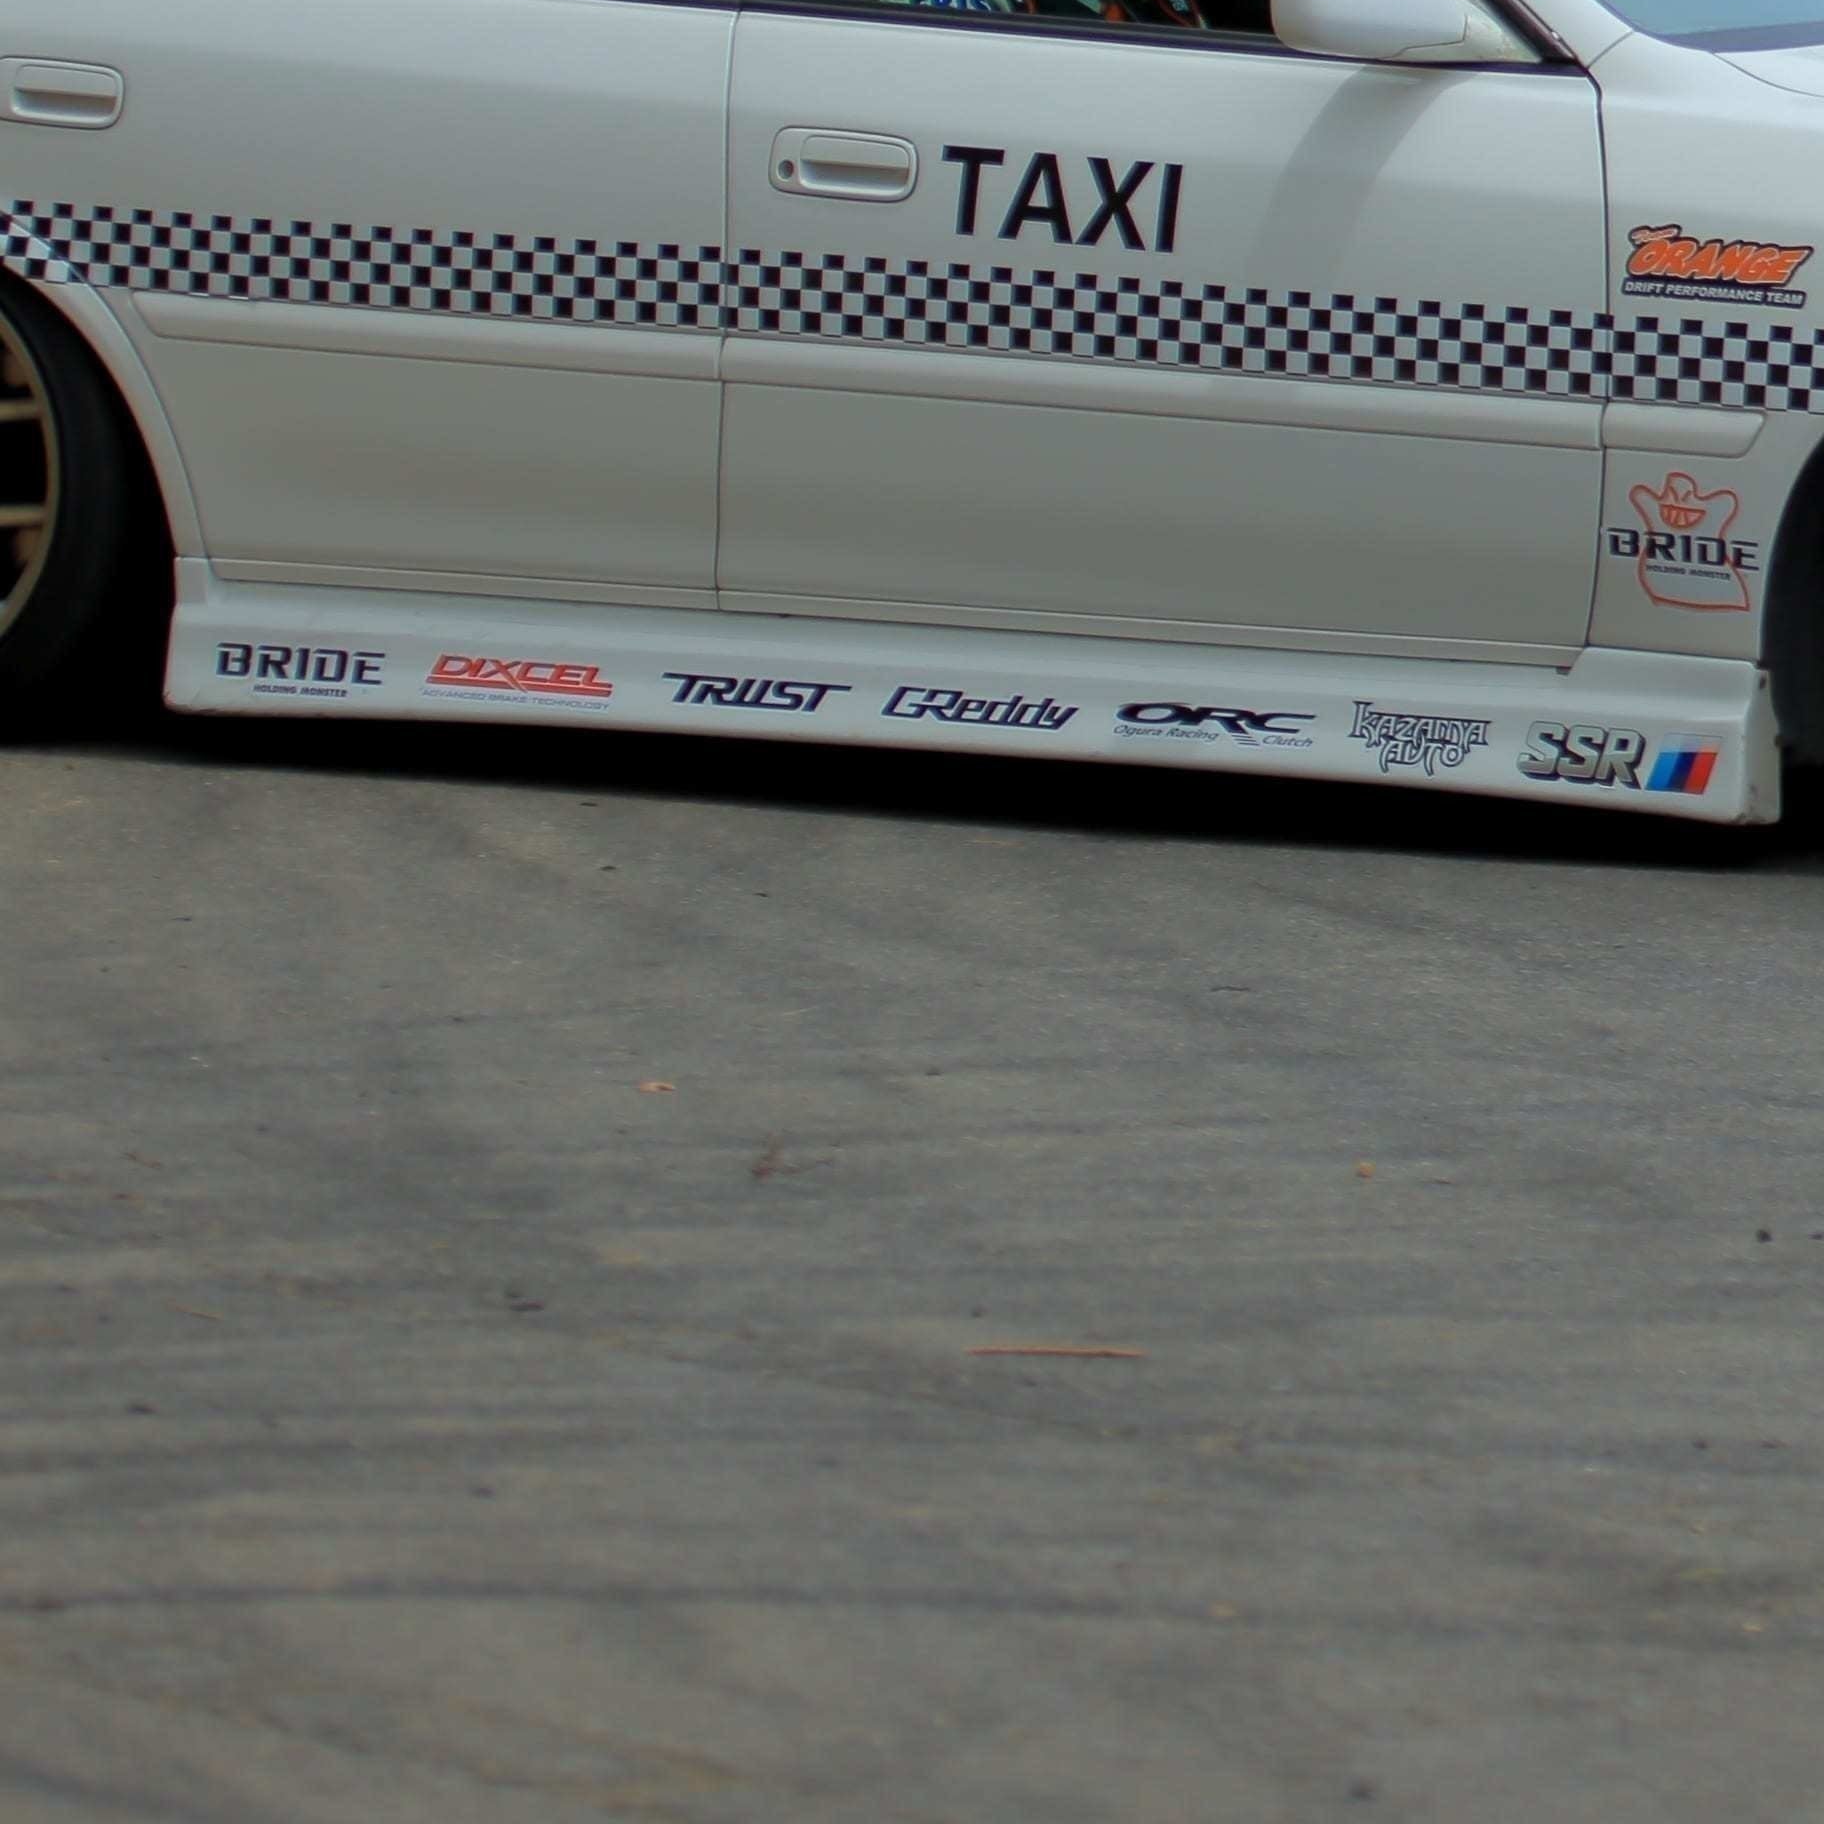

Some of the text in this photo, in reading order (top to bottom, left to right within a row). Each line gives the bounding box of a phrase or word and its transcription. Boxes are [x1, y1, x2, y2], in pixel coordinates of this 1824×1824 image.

[942, 145, 1183, 253] TAXI
[1628, 238, 1808, 283] ORANGE
[1625, 282, 1804, 305] DRIFT PERFORMANCE TEAM
[1607, 528, 1760, 571] BRIDE
[216, 642, 386, 685] BRIDE
[428, 654, 613, 692] DIXCEL
[299, 687, 348, 698] MONSTER
[661, 671, 852, 712] TRUST
[881, 685, 1080, 730] GReddy
[1113, 724, 1314, 748] Ogura Racing Clutch
[1116, 702, 1317, 734] ORC
[1518, 720, 1647, 789] SSR
